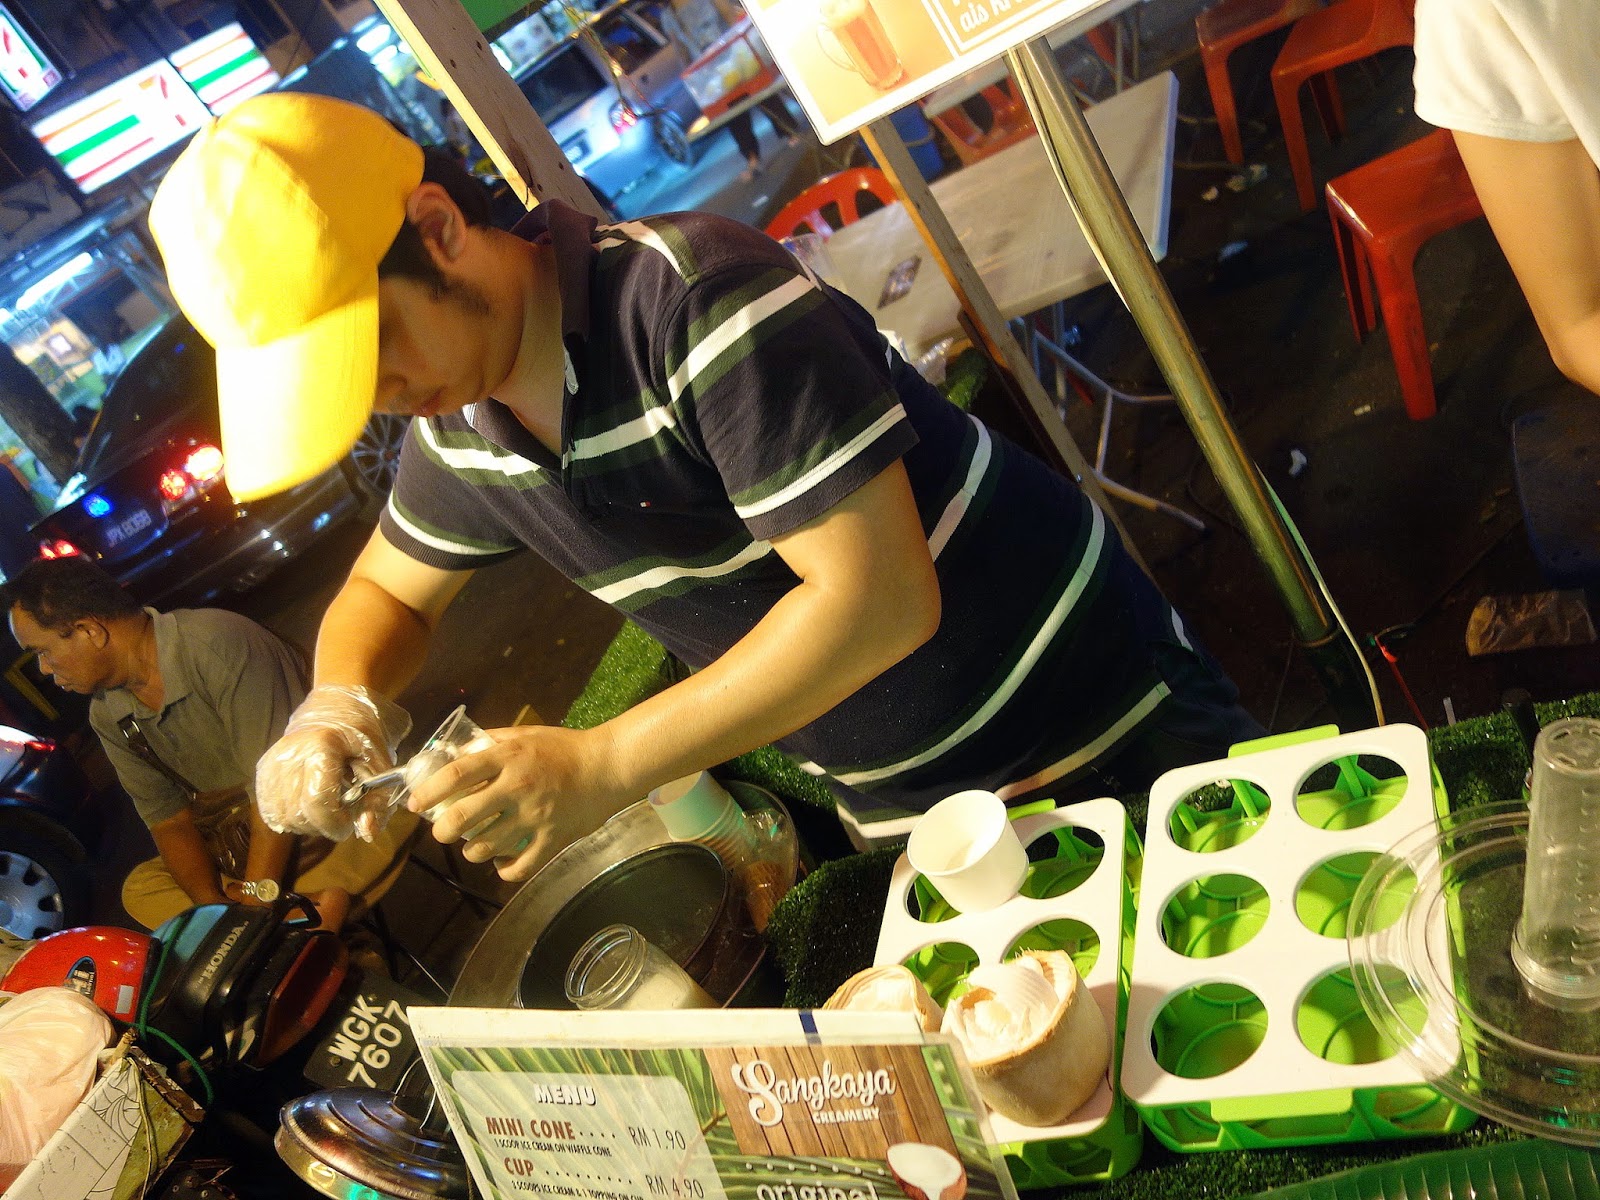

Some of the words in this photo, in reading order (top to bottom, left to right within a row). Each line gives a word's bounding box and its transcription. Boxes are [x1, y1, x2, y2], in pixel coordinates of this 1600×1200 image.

[327, 994, 384, 1062] WGK
[347, 1000, 409, 1088] 7607
[533, 1083, 597, 1106] MENU
[731, 1059, 896, 1127] Sangkaya
[813, 1107, 880, 1124] CREAMERY
[485, 1116, 525, 1138] MINI
[628, 1126, 652, 1148] RM
[652, 1128, 686, 1151] 1.90
[499, 1139, 520, 1149] SCOOP
[520, 1141, 532, 1151] ICE
[531, 1141, 555, 1153] CREAM
[554, 1143, 567, 1153] ON
[565, 1144, 592, 1155] WAFFLE
[592, 1145, 612, 1157] CONE
[504, 1157, 534, 1177] CUP
[645, 1174, 669, 1196] RM
[672, 1177, 704, 1199] 4.90
[516, 1181, 541, 1192] SCOOPS
[540, 1184, 553, 1194] ICE
[552, 1185, 576, 1197] CREAM
[587, 1189, 618, 1200] TOPPING
